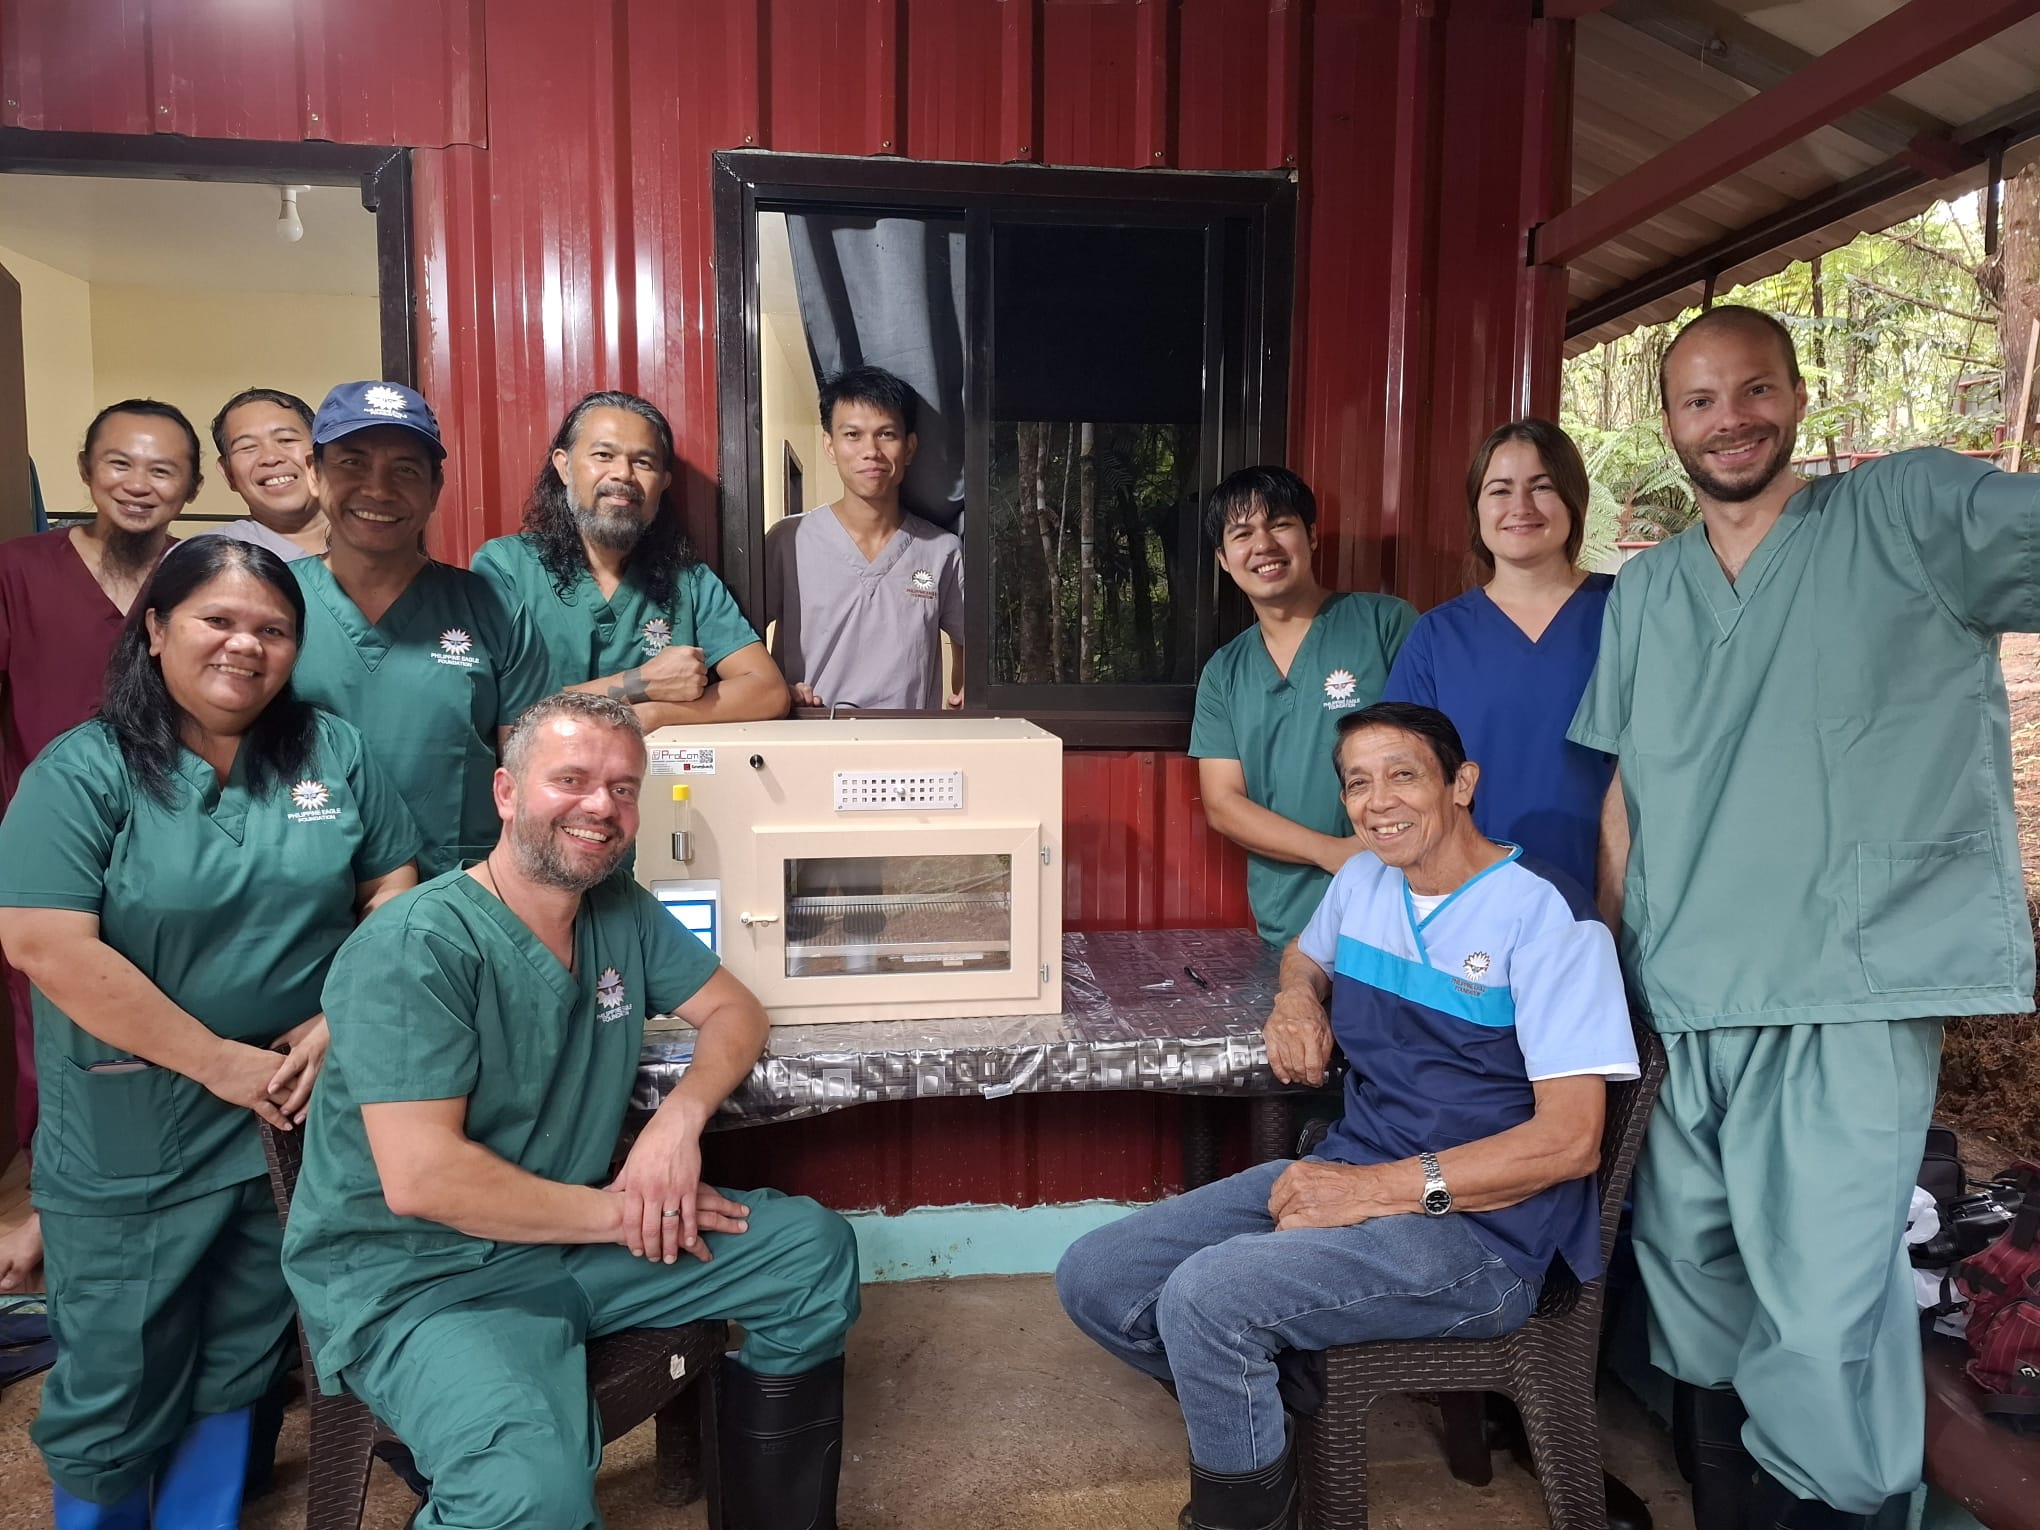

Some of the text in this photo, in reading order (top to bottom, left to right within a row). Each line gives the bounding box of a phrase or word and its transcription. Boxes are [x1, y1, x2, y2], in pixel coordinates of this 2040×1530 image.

[430, 652, 480, 664] PHILIPPINE EAGLE
[437, 658, 473, 668] FOUNDATION
[287, 807, 342, 820] PHILIPPINE EAGLE
[297, 814, 336, 823] FOUNDATION
